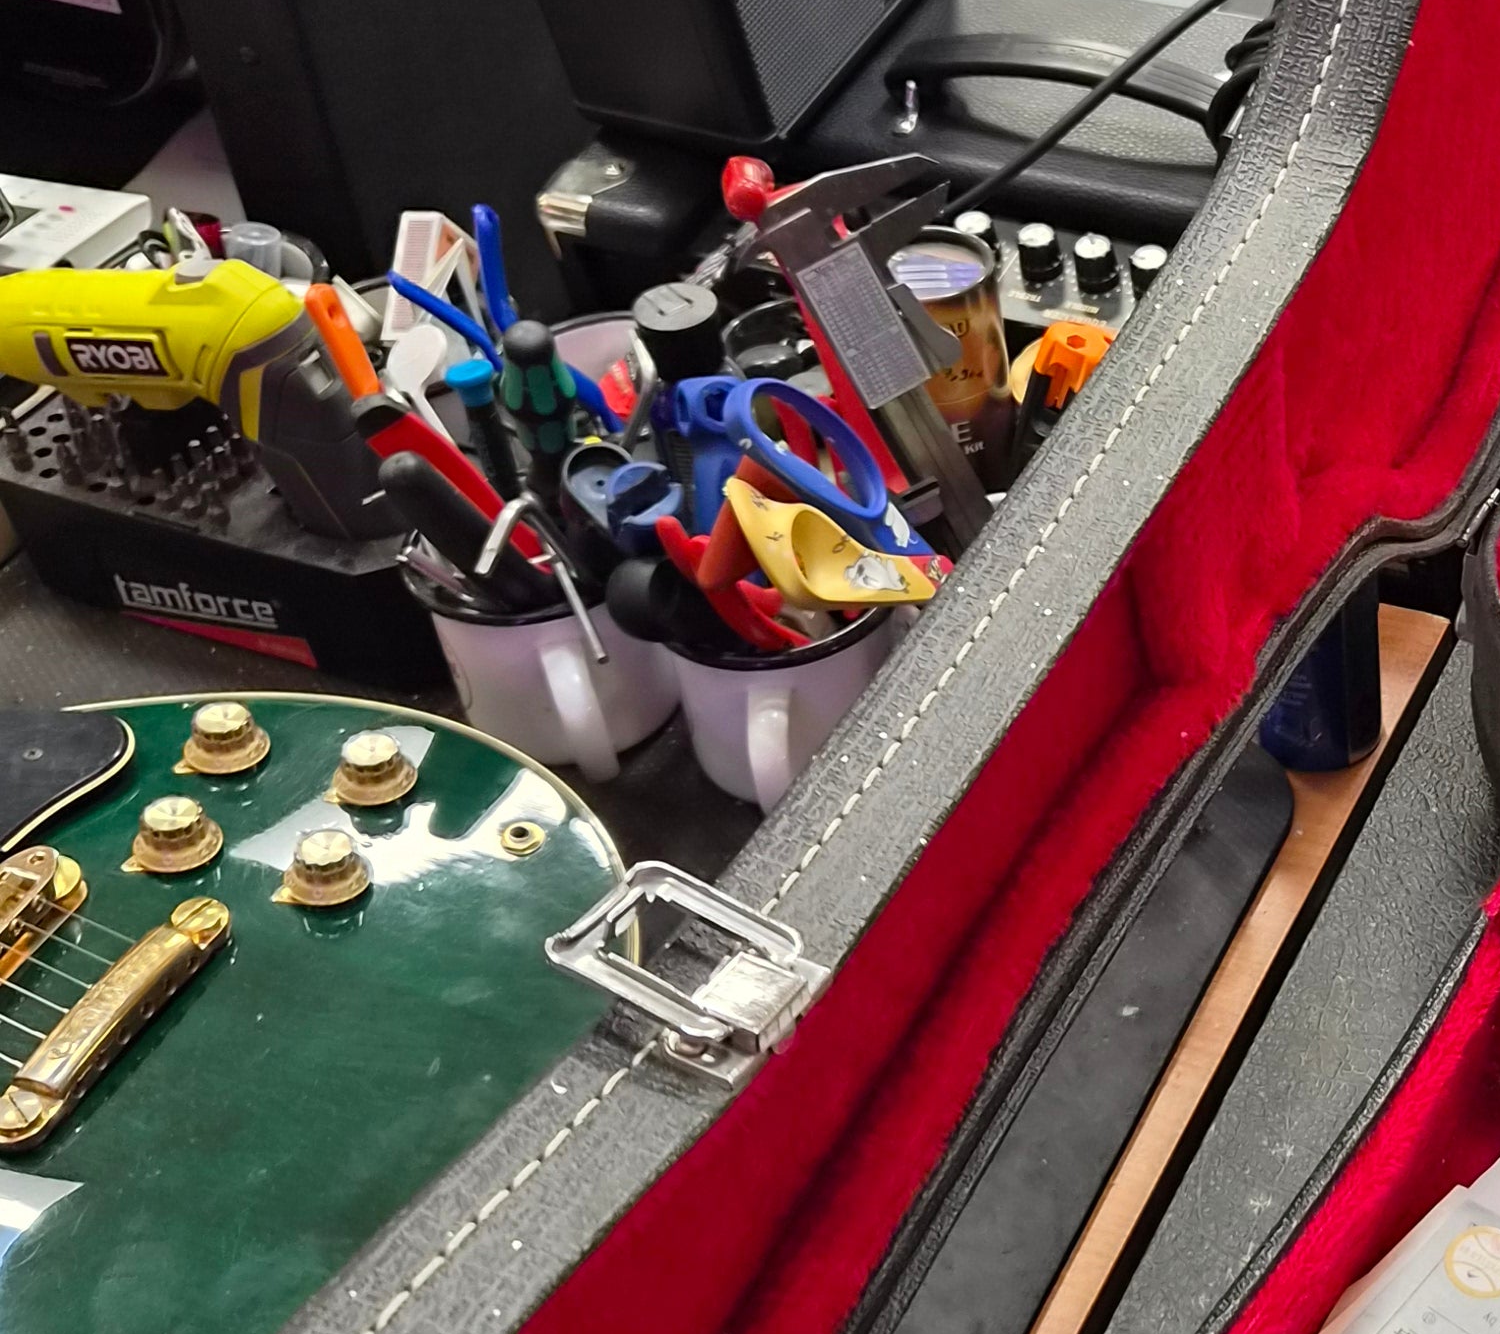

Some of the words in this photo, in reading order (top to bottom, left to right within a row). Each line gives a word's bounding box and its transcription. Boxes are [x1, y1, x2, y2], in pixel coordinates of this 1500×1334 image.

[70, 343, 160, 372] RYOBI
[114, 573, 275, 622] tamforce
[1483, 1311, 1498, 1327] by
